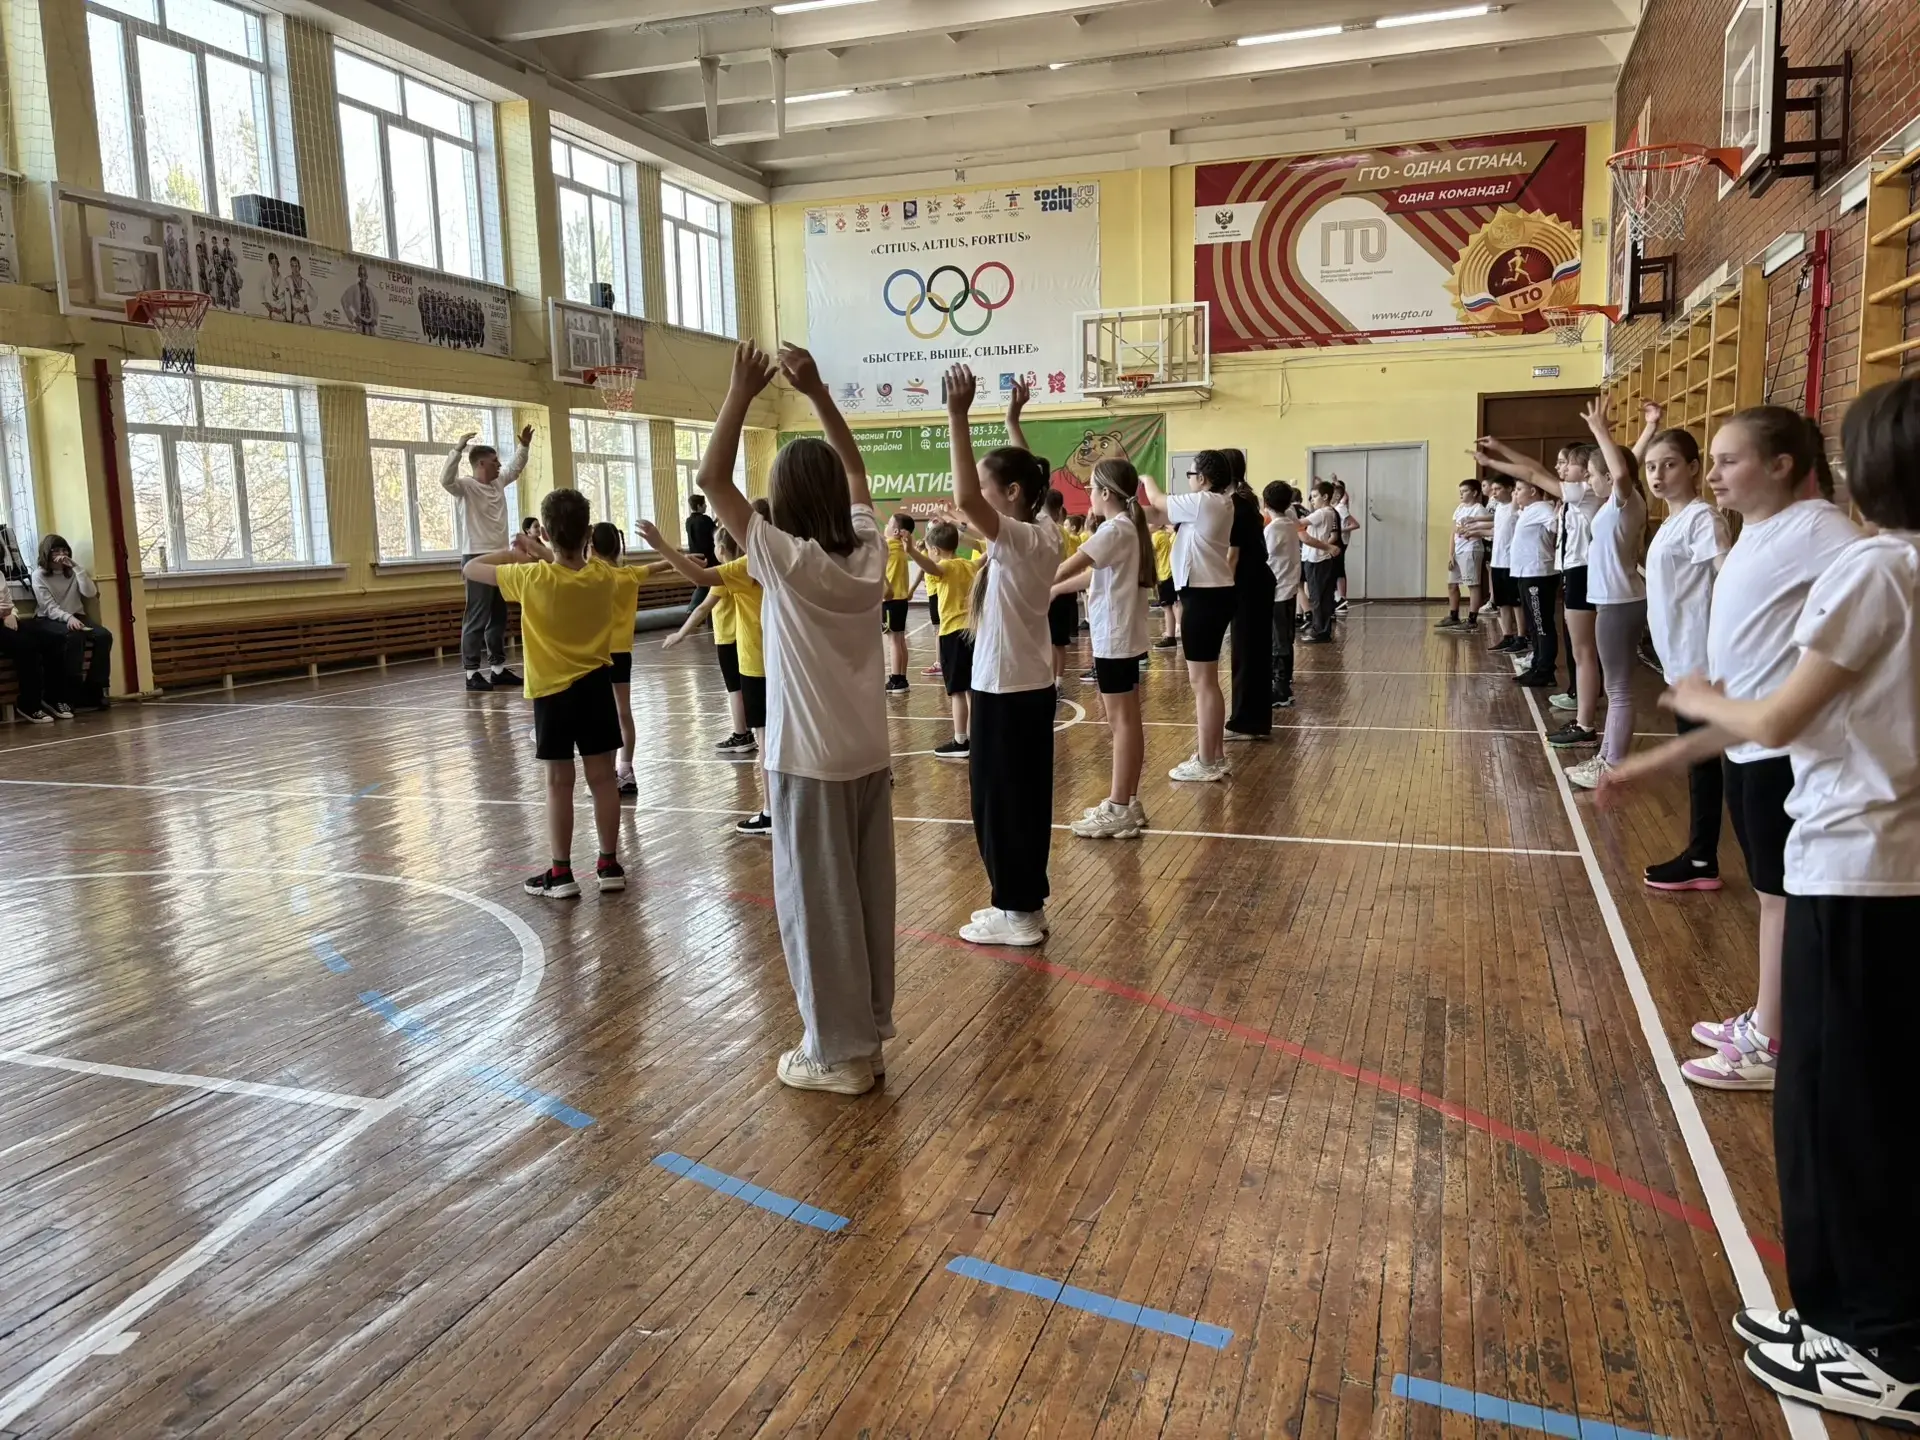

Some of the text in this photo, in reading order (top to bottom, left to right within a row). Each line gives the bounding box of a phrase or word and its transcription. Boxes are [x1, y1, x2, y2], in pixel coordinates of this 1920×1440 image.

[1358, 165, 1389, 182] ГТО
[1403, 160, 1451, 178] ОДНА
[1456, 152, 1528, 172] СТРАНА,
[1398, 181, 1511, 204] одна команда!
[871, 231, 1031, 255] «CITIUS, ALTIUS, FORTIUS»
[1321, 218, 1387, 266] ГТО
[1509, 287, 1543, 308] ГТО
[1371, 309, 1433, 321] www.gto.ru
[863, 343, 1039, 364] «БЫСТРЕЕ, ВЫШЕ, СИЛЬНЕЕ»
[886, 430, 903, 439] ГТО
[935, 428, 941, 437] 8
[872, 443, 903, 453] района
